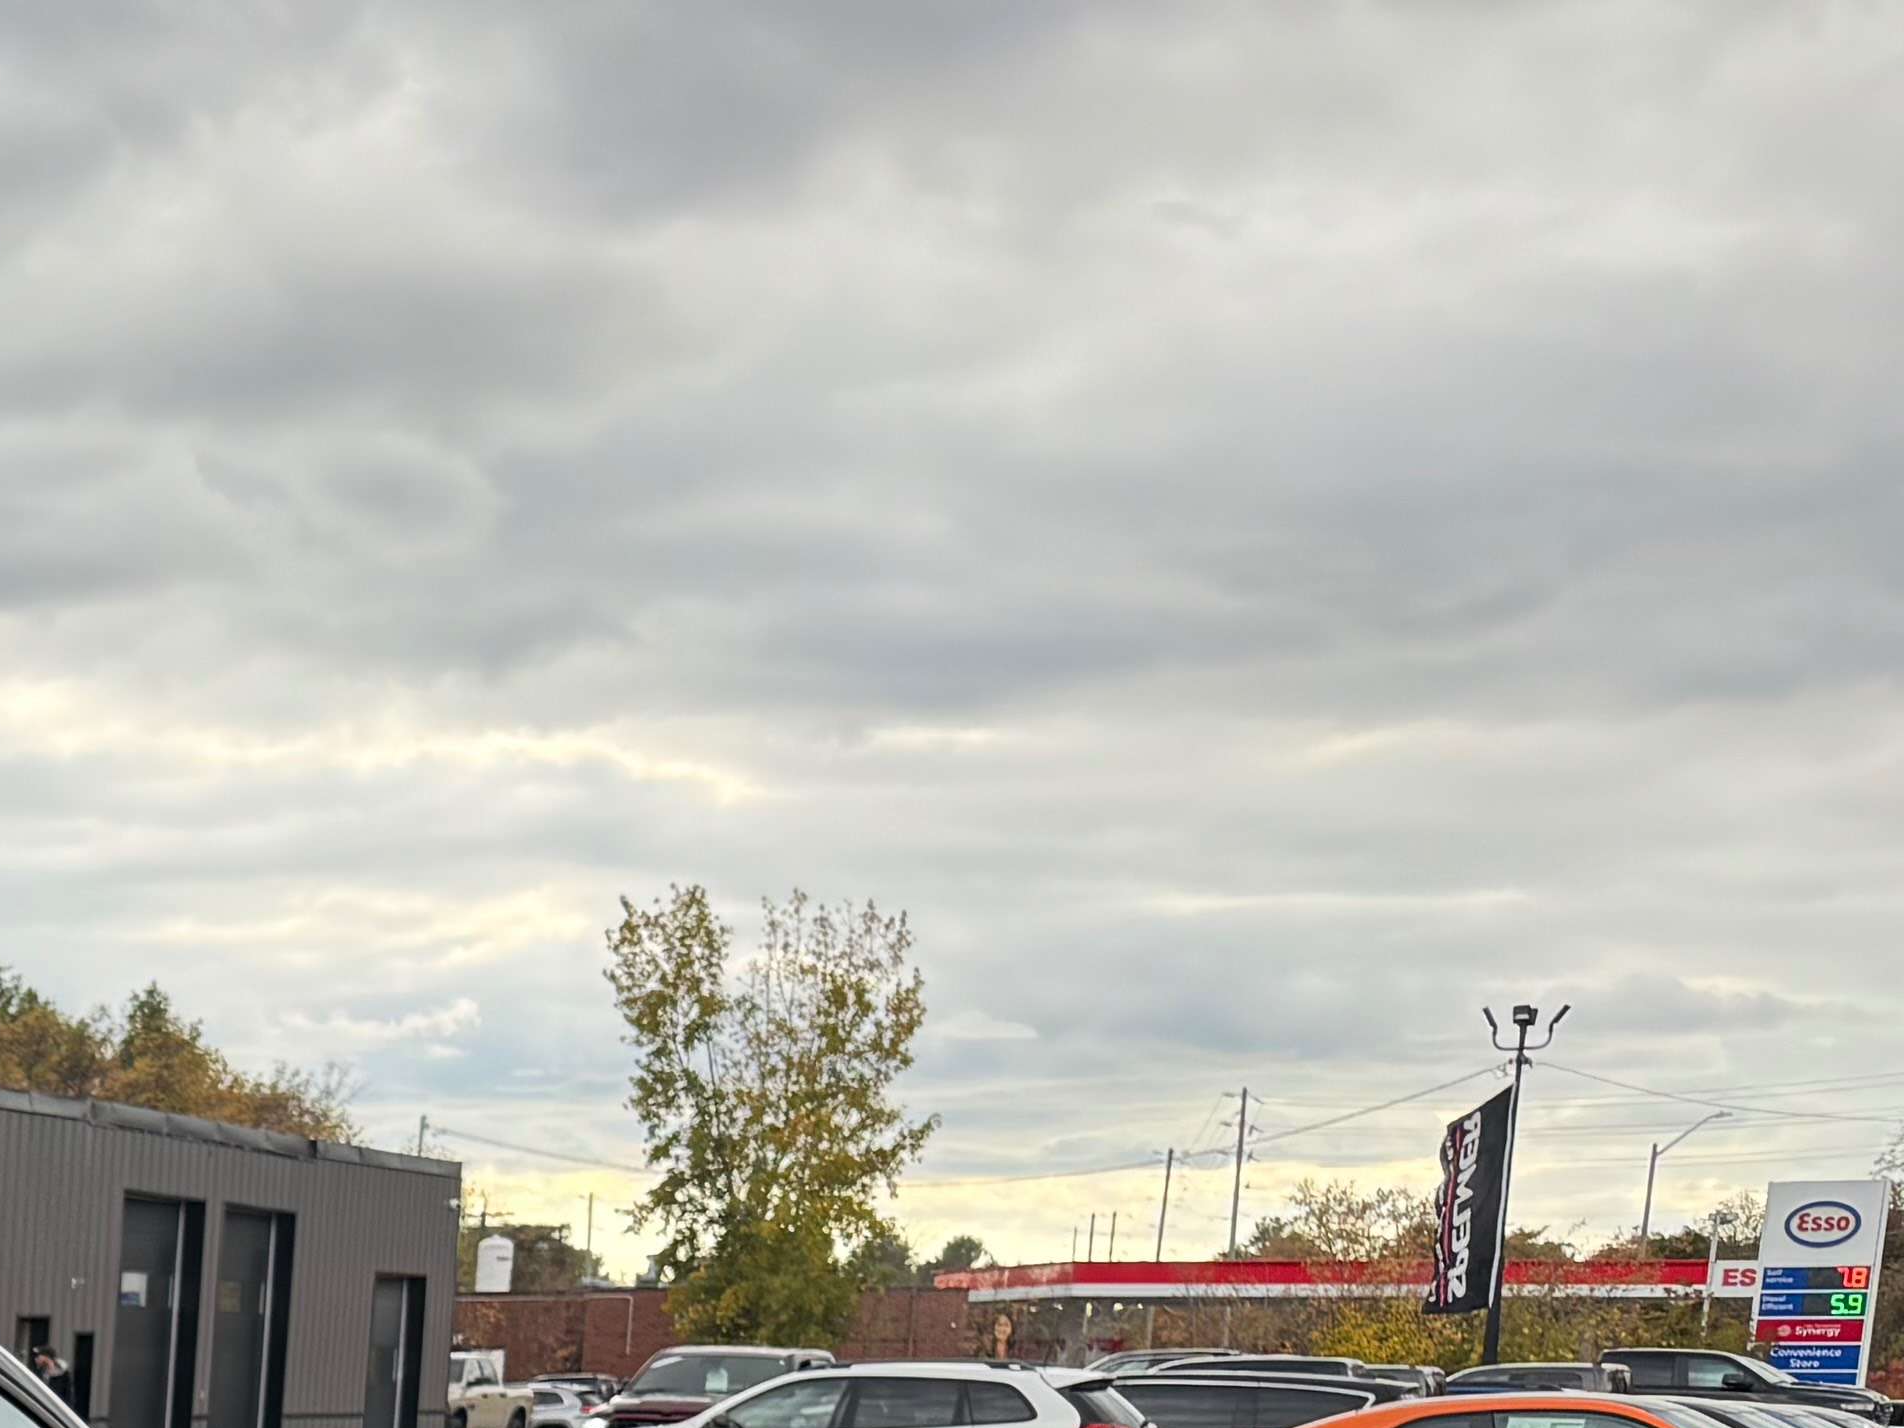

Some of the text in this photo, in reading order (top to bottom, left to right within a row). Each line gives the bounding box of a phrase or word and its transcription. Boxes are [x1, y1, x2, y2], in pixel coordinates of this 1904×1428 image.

[1446, 1110, 1482, 1303] SPELMER
[1796, 1212, 1851, 1232] Esso
[1770, 1346, 1842, 1358] Convenience
